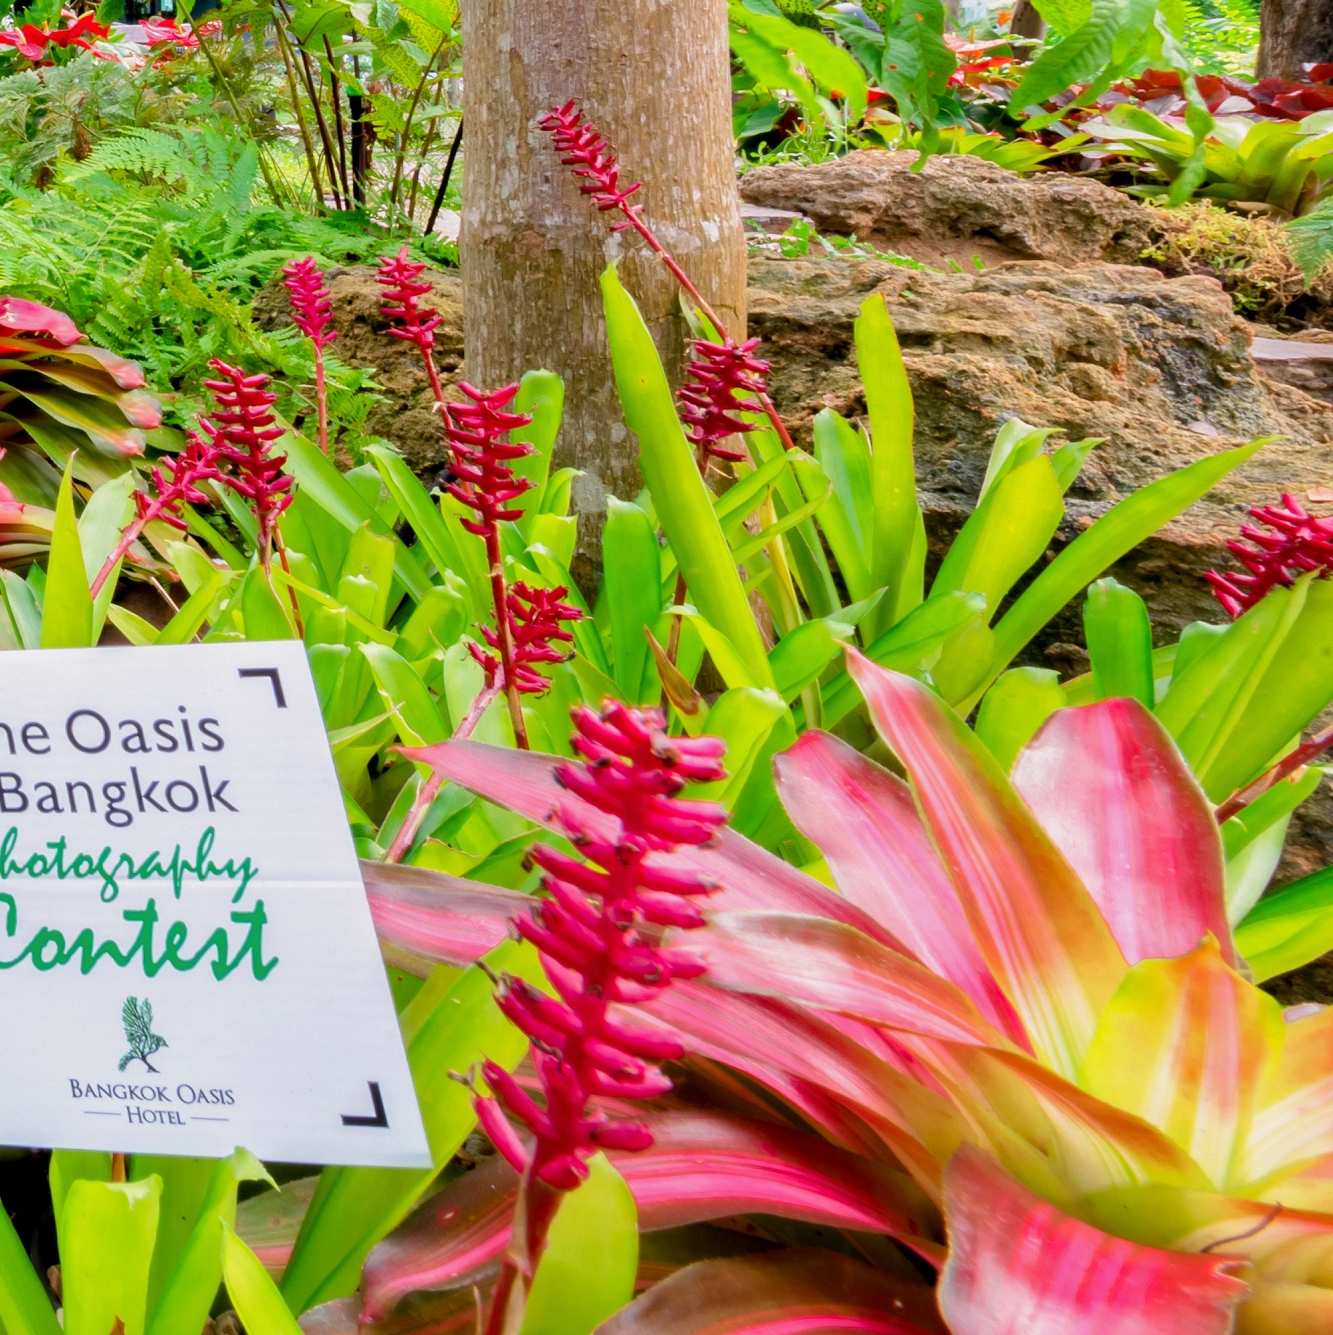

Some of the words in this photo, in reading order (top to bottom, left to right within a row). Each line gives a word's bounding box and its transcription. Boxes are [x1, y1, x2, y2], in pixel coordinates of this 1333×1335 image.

[65, 705, 225, 755] Oasis
[69, 1078, 172, 1102] BANGKOK
[176, 1084, 235, 1105] OASIS
[126, 1106, 186, 1125] HOTEL
